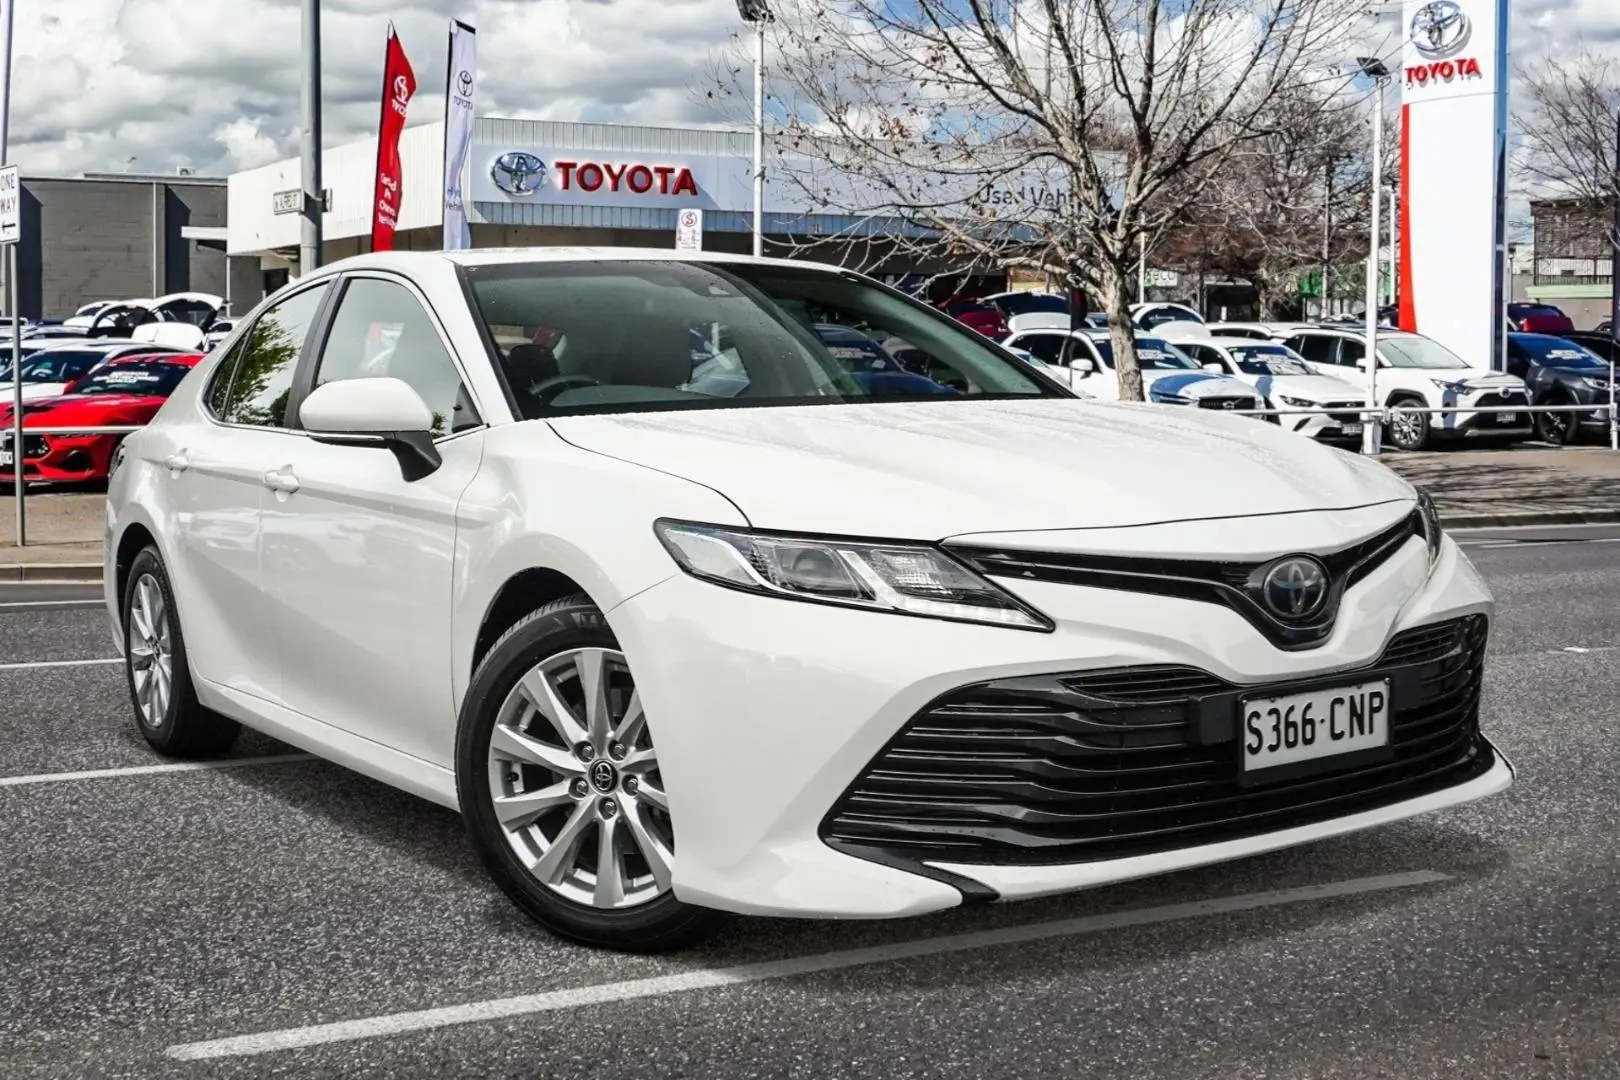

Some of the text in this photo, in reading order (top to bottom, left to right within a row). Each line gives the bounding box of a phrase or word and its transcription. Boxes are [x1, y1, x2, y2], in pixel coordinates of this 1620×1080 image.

[1404, 58, 1481, 83] TOYOTA
[1, 173, 15, 191] ONE
[555, 161, 698, 196] TOYOTA
[1, 195, 16, 213] WAY
